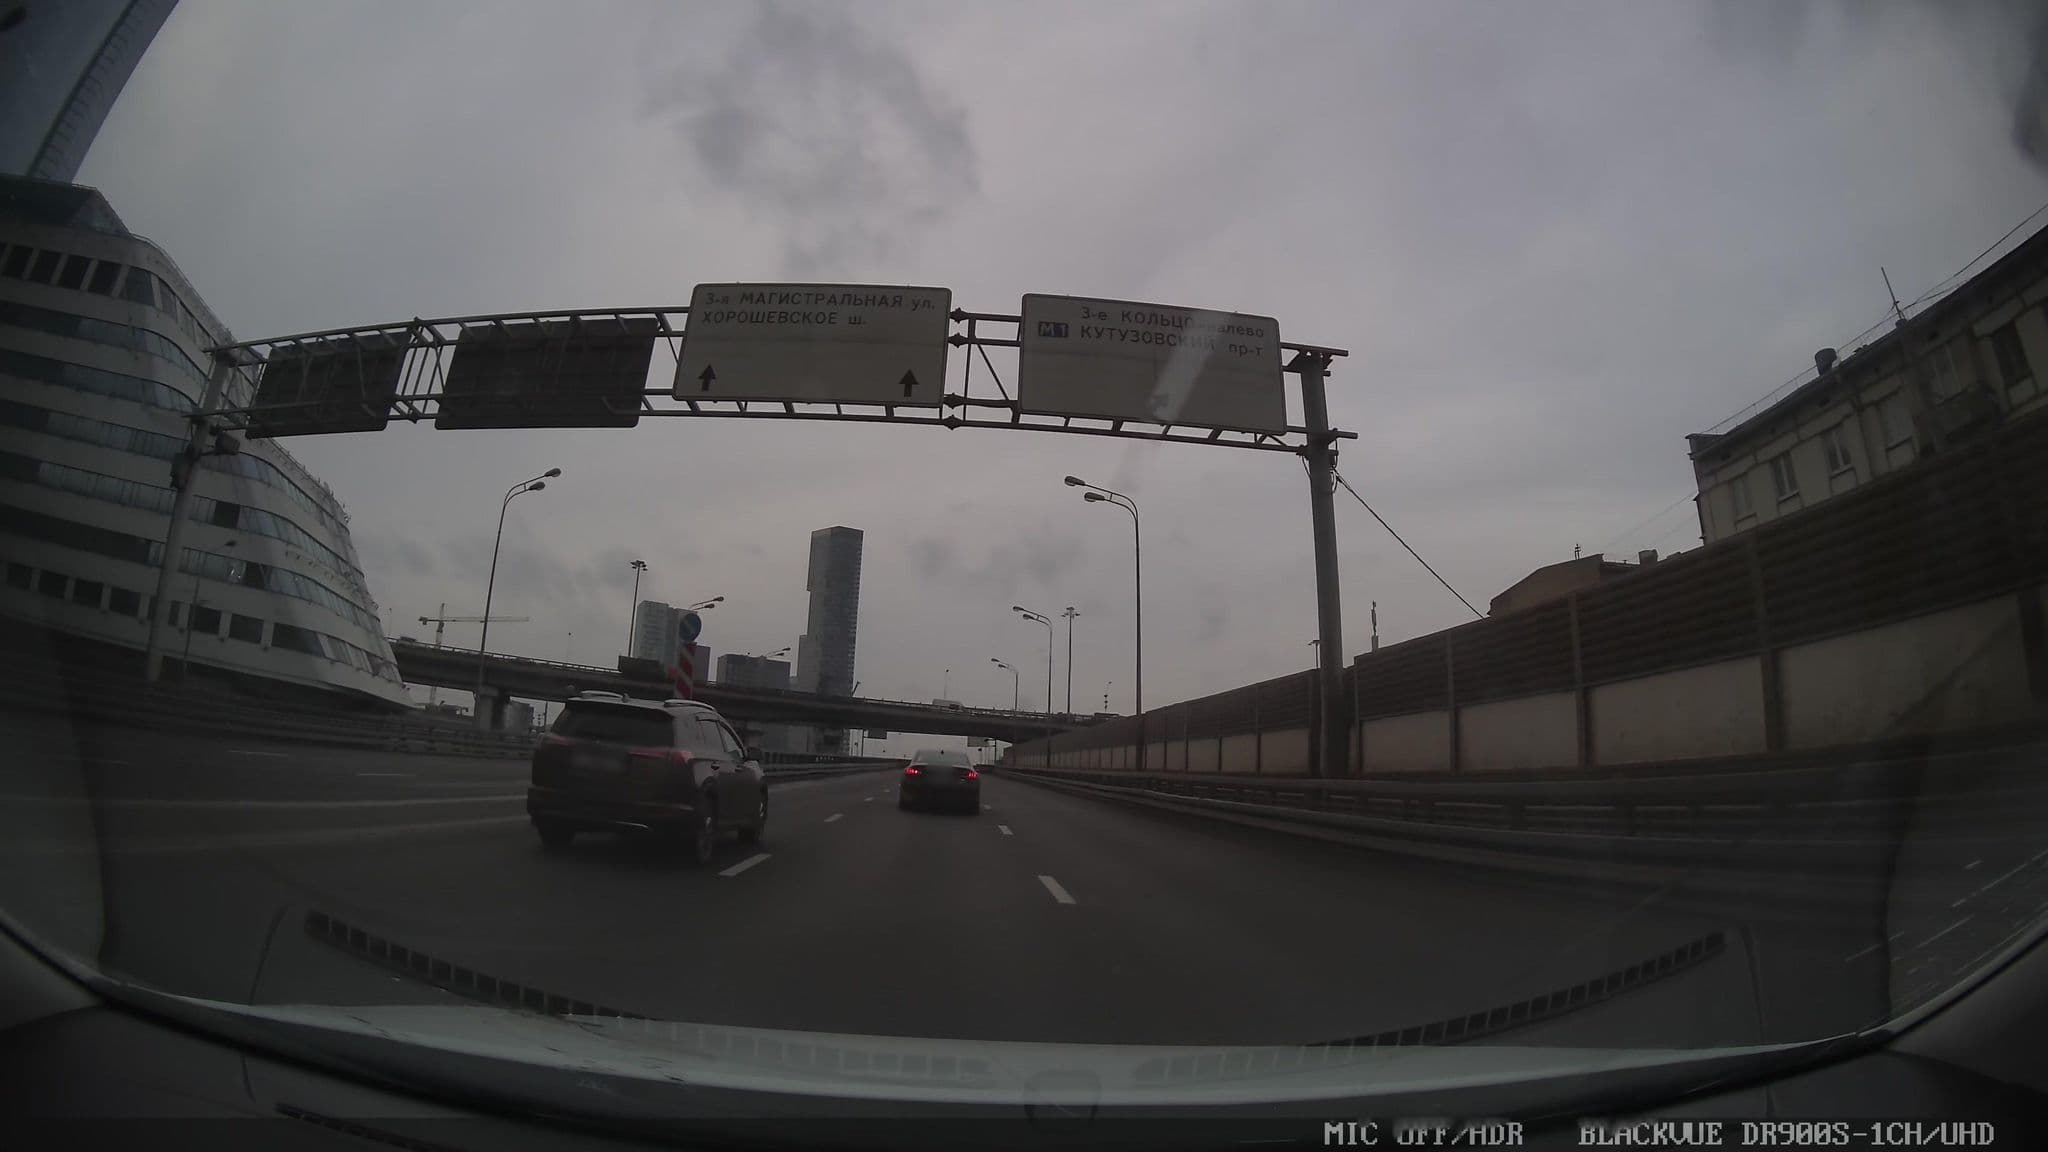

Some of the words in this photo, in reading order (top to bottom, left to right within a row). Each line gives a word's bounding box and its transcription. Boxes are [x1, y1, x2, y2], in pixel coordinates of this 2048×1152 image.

[705, 292, 729, 305] 3-я
[740, 292, 904, 308] МАГИСТРАЛЬНАЯ
[911, 297, 936, 311] ул.
[702, 310, 838, 325] ХОРОШЕВСКОЕ
[847, 314, 867, 325] ш.
[1081, 306, 1108, 321] 3-е
[1228, 343, 1264, 357] пр-т
